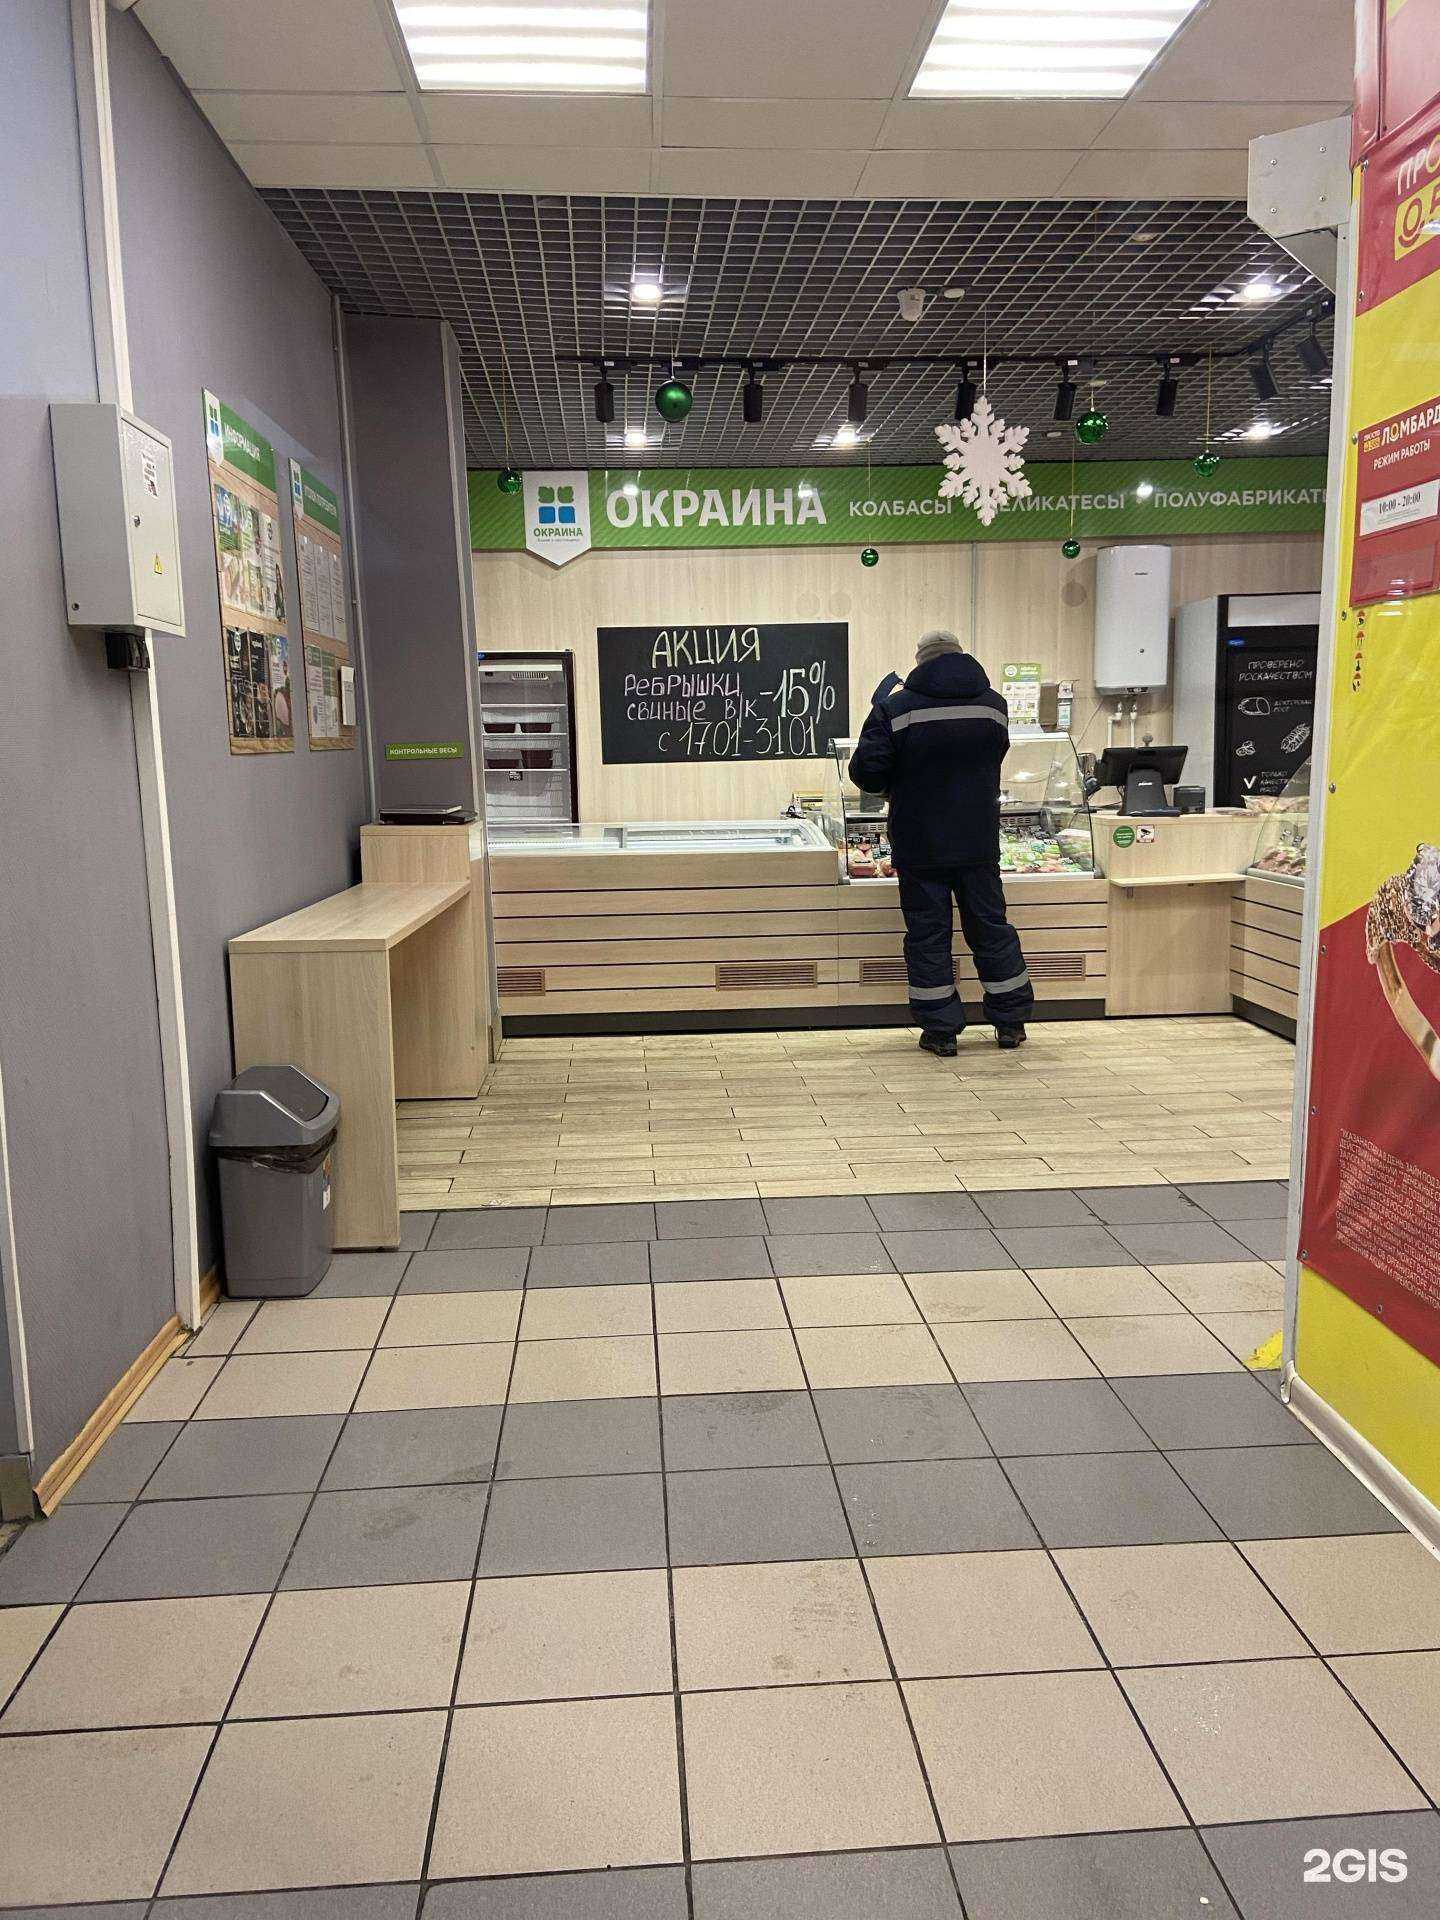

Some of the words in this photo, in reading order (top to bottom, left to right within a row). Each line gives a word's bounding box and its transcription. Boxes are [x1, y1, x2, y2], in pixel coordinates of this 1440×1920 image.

[1381, 405, 1440, 446] ЛОМБАРД
[1373, 450, 1400, 470] РЕЖИМ
[1400, 438, 1431, 460] РАБОТЫ
[606, 488, 827, 528] ОКРАИНА
[849, 499, 952, 517] КОЛБАСЫ
[995, 493, 1125, 513] ЕЛИКАТЕСЫ
[533, 527, 583, 537] ОКРАИНА
[651, 627, 760, 669] АКЦИЯ
[1248, 659, 1305, 670] ПРОВЕРЕНО
[1238, 671, 1313, 682] РОСКАЧЕСТВОМ
[389, 747, 438, 755] КОНТРОЛЬНЫЕ
[439, 746, 458, 754] ВЕСЫ
